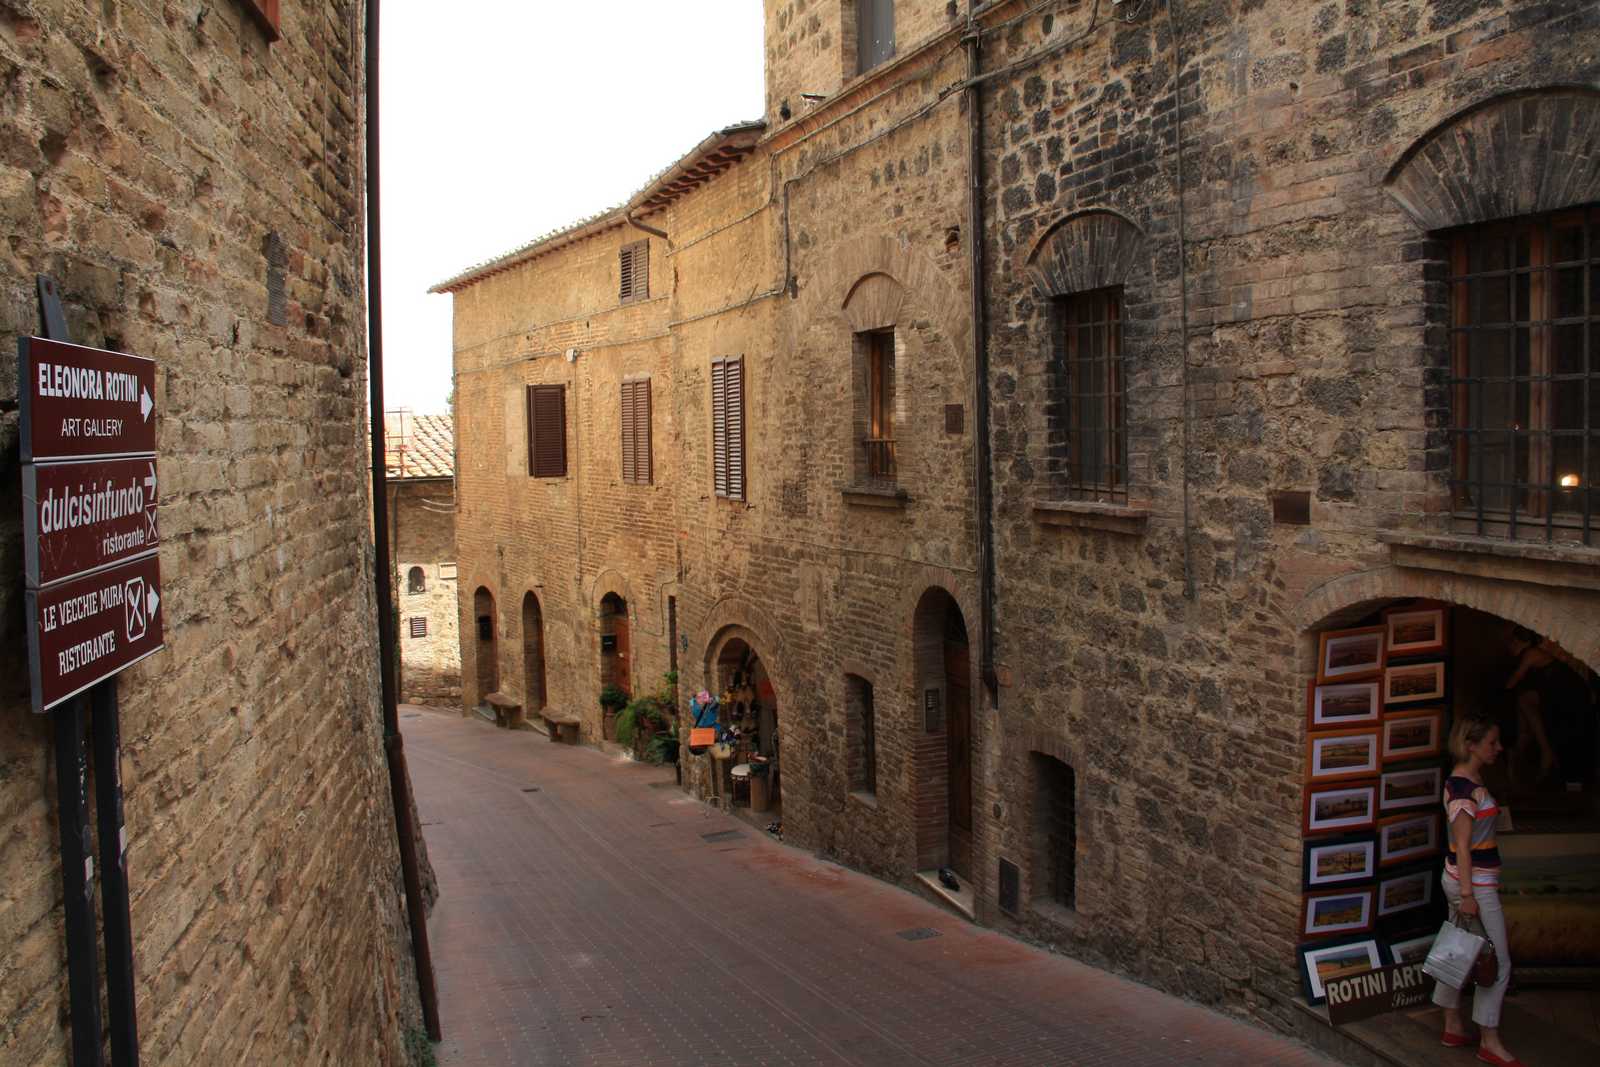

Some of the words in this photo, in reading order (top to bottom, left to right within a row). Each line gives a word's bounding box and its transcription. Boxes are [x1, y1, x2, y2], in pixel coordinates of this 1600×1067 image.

[38, 363, 103, 399] ELEONORA
[105, 372, 138, 402] ROTINI
[61, 418, 81, 438] ART
[84, 418, 123, 437] GALLERY
[41, 481, 143, 534] dulcisinfundo
[103, 528, 145, 556] ristorante
[44, 606, 57, 633] LE
[59, 595, 98, 627] VECCHIE
[100, 584, 124, 613] MURA
[58, 630, 116, 676] RISTORANTE
[1327, 971, 1388, 1005] ROTINI
[1391, 963, 1425, 991] ART
